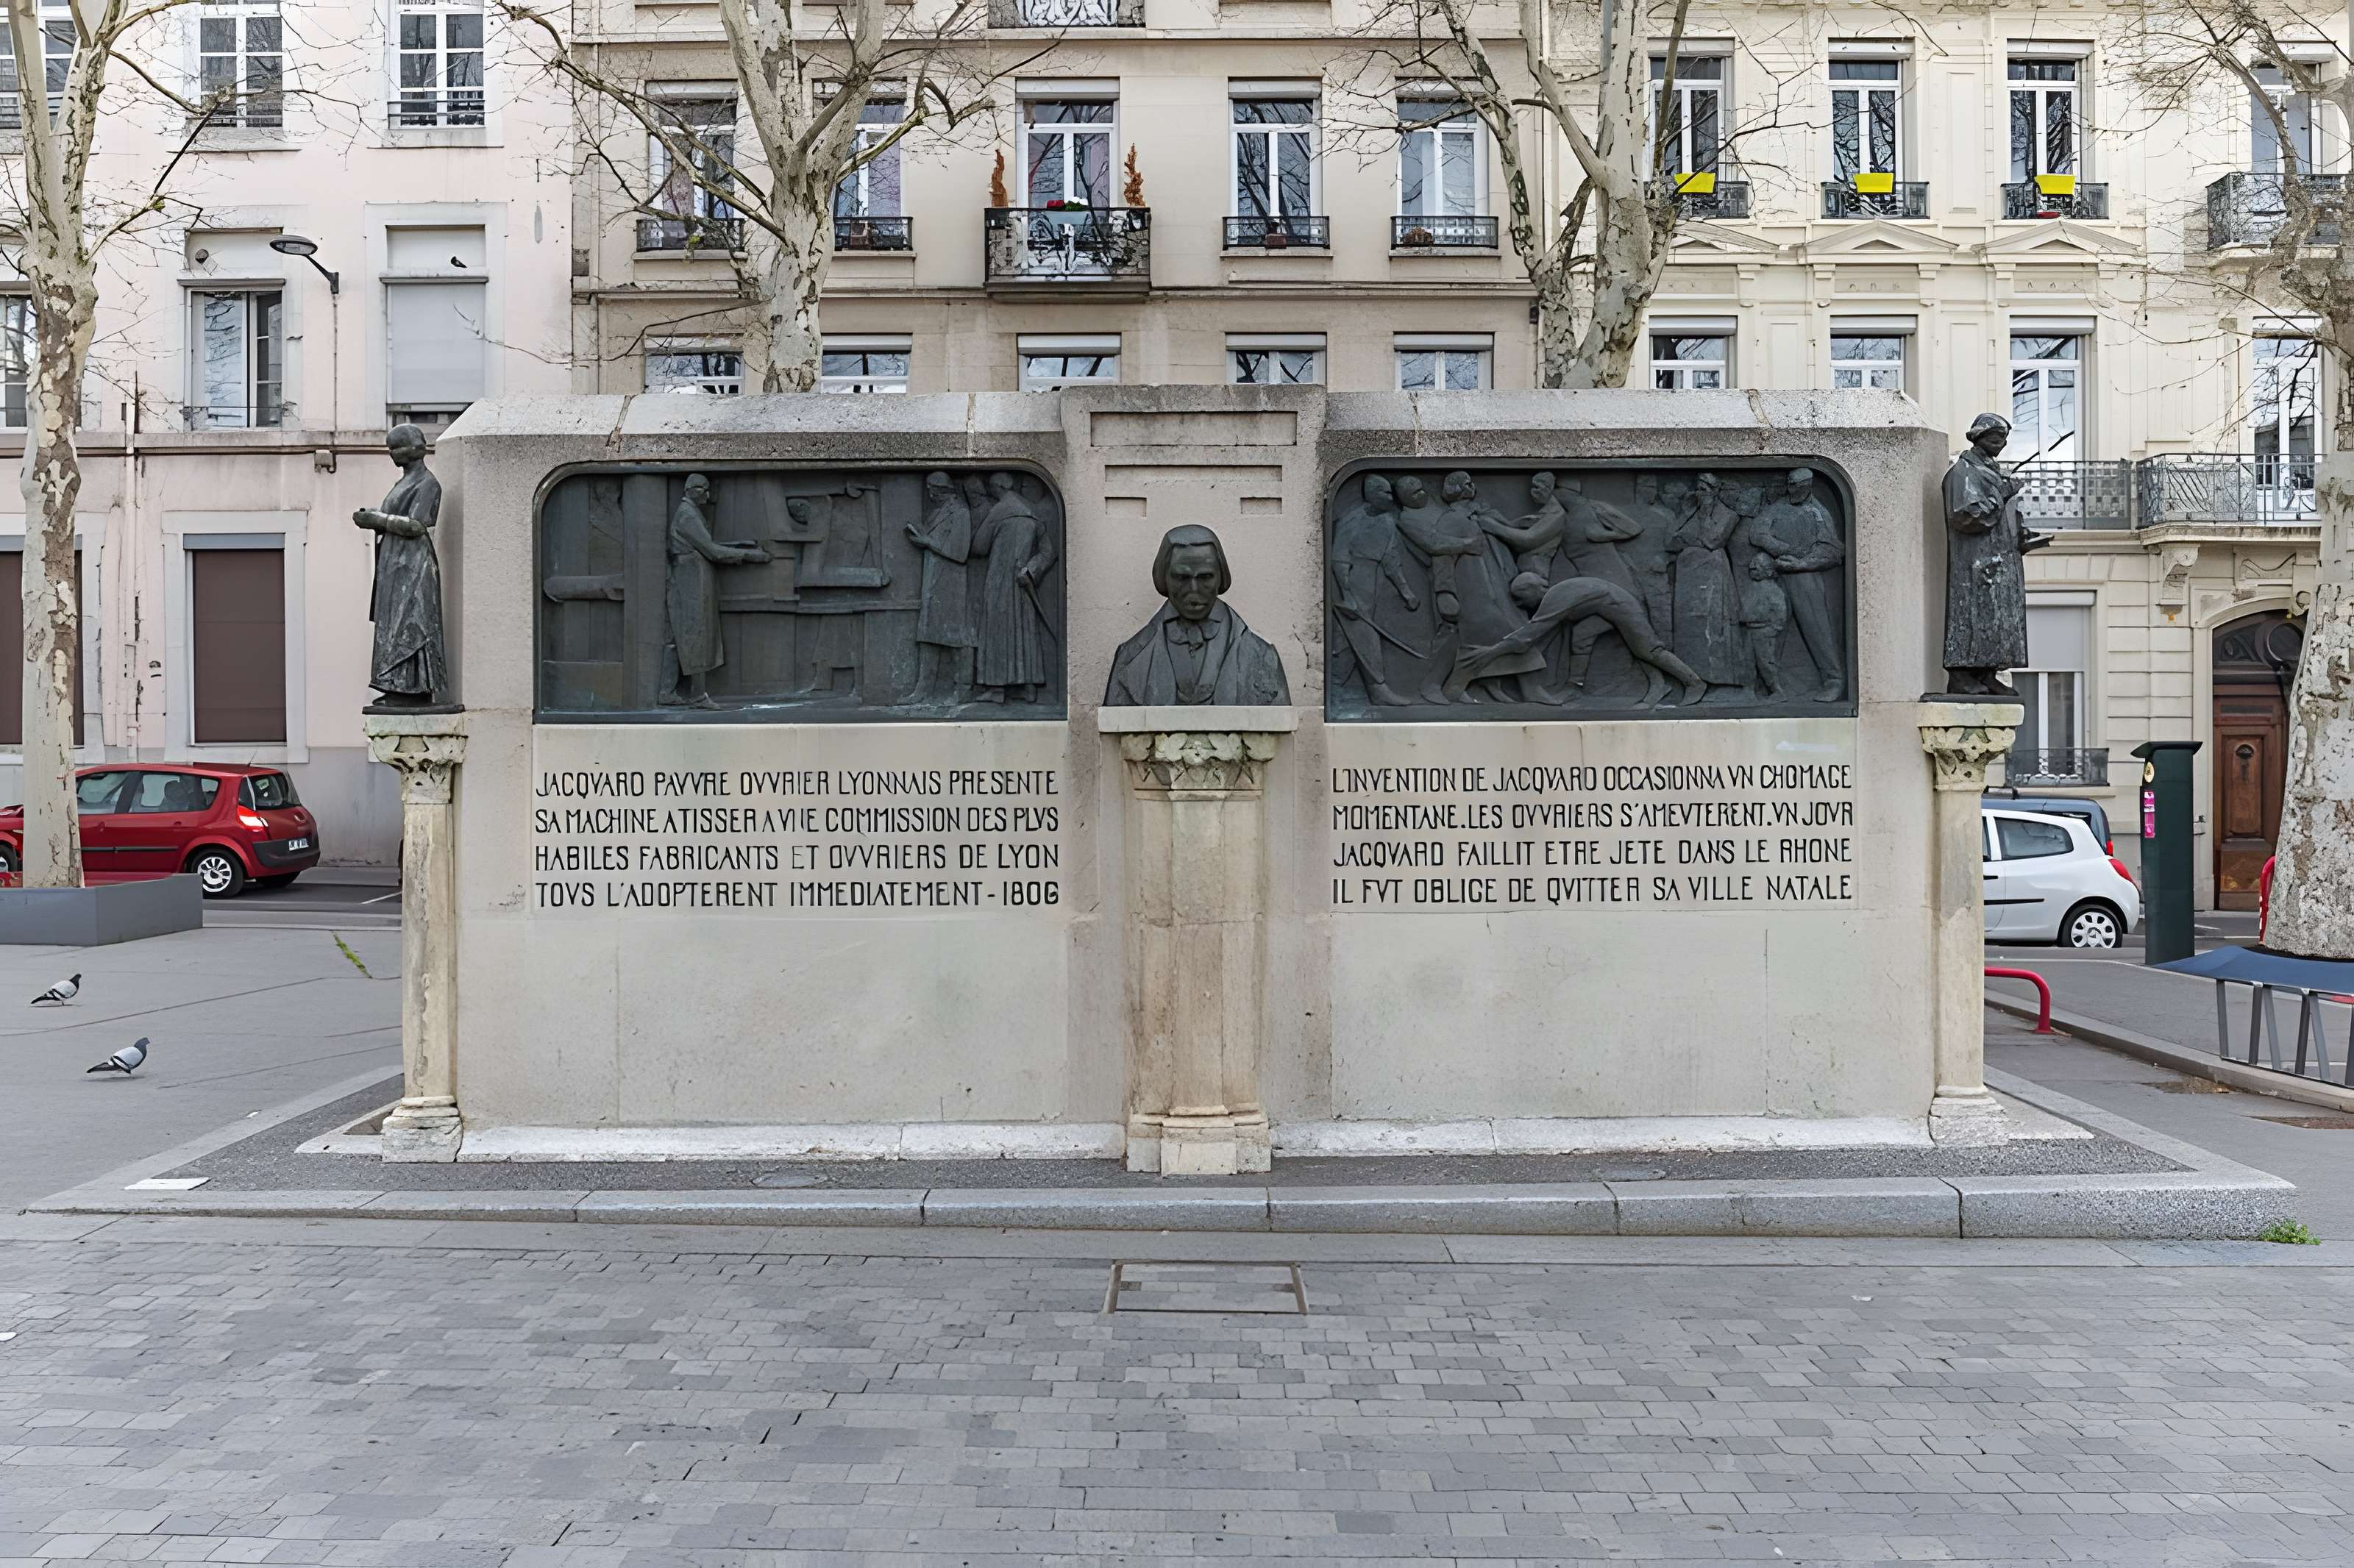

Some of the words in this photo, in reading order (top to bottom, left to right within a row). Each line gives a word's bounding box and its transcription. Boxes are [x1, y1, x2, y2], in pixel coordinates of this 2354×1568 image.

[536, 771, 644, 799] JACQVARD
[654, 771, 731, 797] PAVVRE
[740, 771, 830, 796] OVVRIER
[839, 770, 942, 796] LYONNAIS
[949, 770, 1059, 796] PRESENTE
[1462, 767, 1488, 792] DE
[1493, 766, 1597, 795] JACQVARD
[1604, 765, 1726, 791] OCCASIONNA
[1760, 764, 1852, 789] CHOMAGE
[536, 808, 561, 834] SA
[566, 808, 659, 834] MACHINE
[825, 807, 961, 834] COMMISSION
[967, 806, 1007, 833] DES
[1013, 806, 1059, 833] PLVS
[1468, 804, 1503, 830] LES
[1802, 801, 1853, 827] JOVR
[536, 845, 629, 872] HABILES
[639, 845, 778, 871] FABRICANTS
[792, 844, 819, 870] ET
[829, 844, 946, 869] OVVRIERS
[959, 844, 988, 869] DE
[998, 843, 1059, 869] LYON
[1333, 841, 1444, 869] JACQVARD
[1457, 841, 1535, 866] FAILLIT
[1545, 840, 1601, 866] ETRE
[1610, 839, 1666, 865] JETE
[1678, 839, 1735, 864] DANS
[1745, 838, 1770, 863] LE
[1779, 838, 1852, 863] RHONE
[536, 882, 594, 908] TOVS
[607, 882, 778, 908] L'ADOPTERENT
[1333, 878, 1354, 904] IL
[1362, 878, 1404, 904] FVT
[1414, 878, 1498, 904] OBLIGE
[1508, 877, 1536, 903] DE
[1547, 877, 1640, 906] QVITTER
[1653, 876, 1681, 901] SA
[1688, 876, 1753, 901] VILLE
[1766, 874, 1852, 901] NATALE
